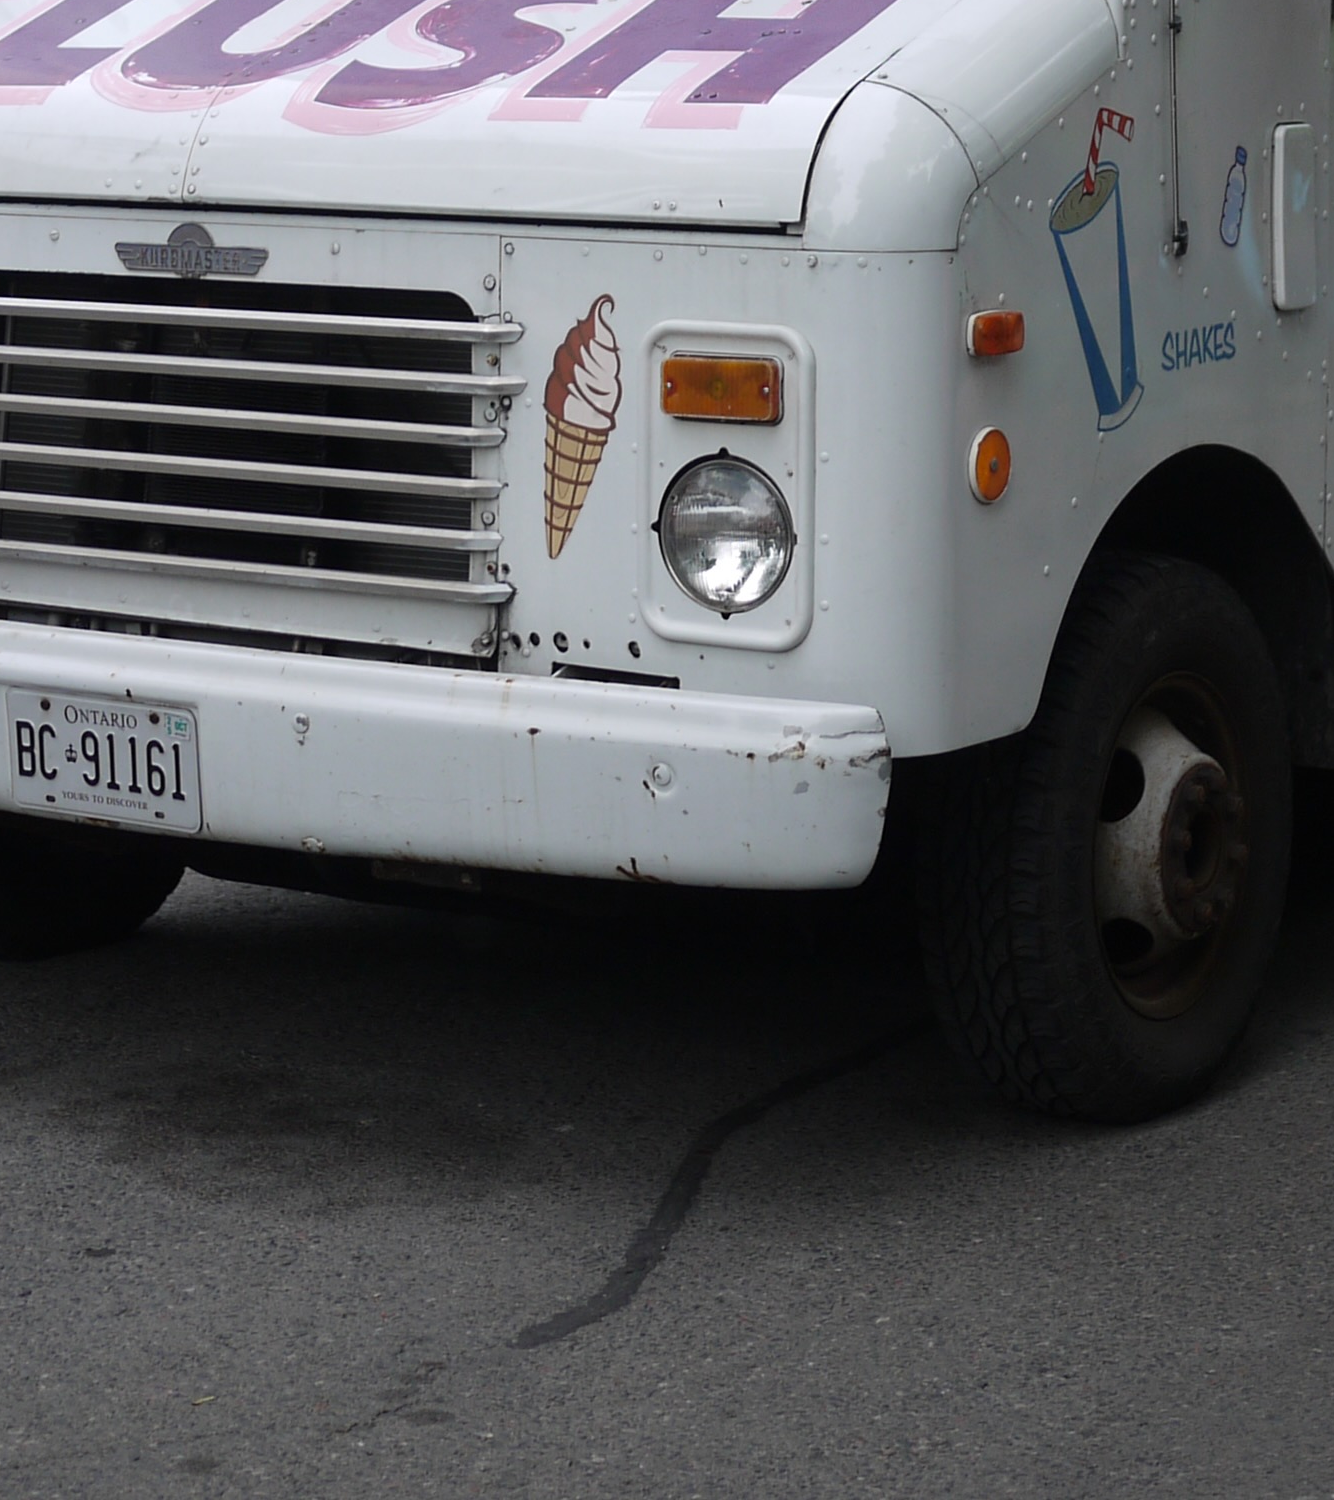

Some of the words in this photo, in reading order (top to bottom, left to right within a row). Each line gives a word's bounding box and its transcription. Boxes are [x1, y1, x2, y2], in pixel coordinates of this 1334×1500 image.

[1161, 321, 1236, 372] SHAKES
[64, 705, 138, 731] ONTARIO
[62, 789, 90, 803] YOURS
[91, 795, 105, 805] TO
[106, 797, 149, 812] DISCOVER
